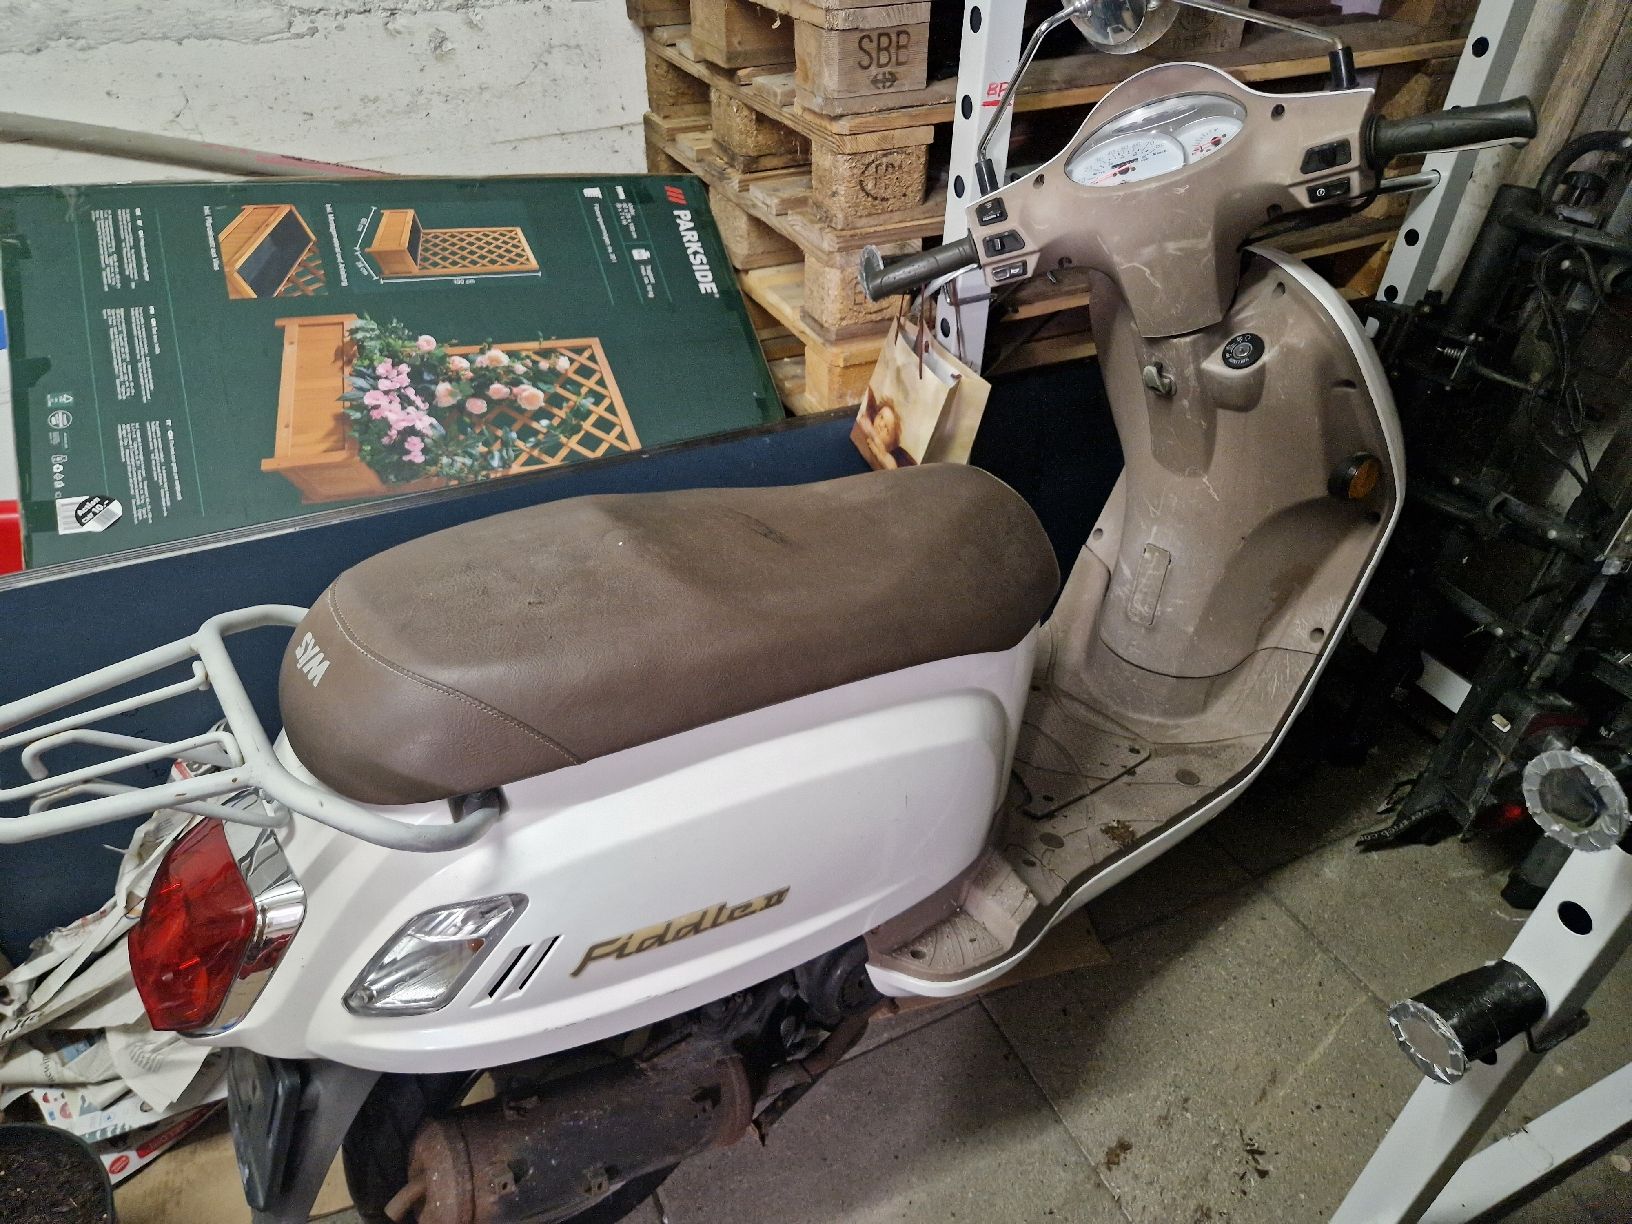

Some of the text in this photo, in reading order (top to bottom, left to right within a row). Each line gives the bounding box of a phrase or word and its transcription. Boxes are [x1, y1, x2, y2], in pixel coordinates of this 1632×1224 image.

[857, 30, 911, 70] SBB
[673, 209, 718, 296] PARKSIDE
[294, 630, 331, 688] SYM
